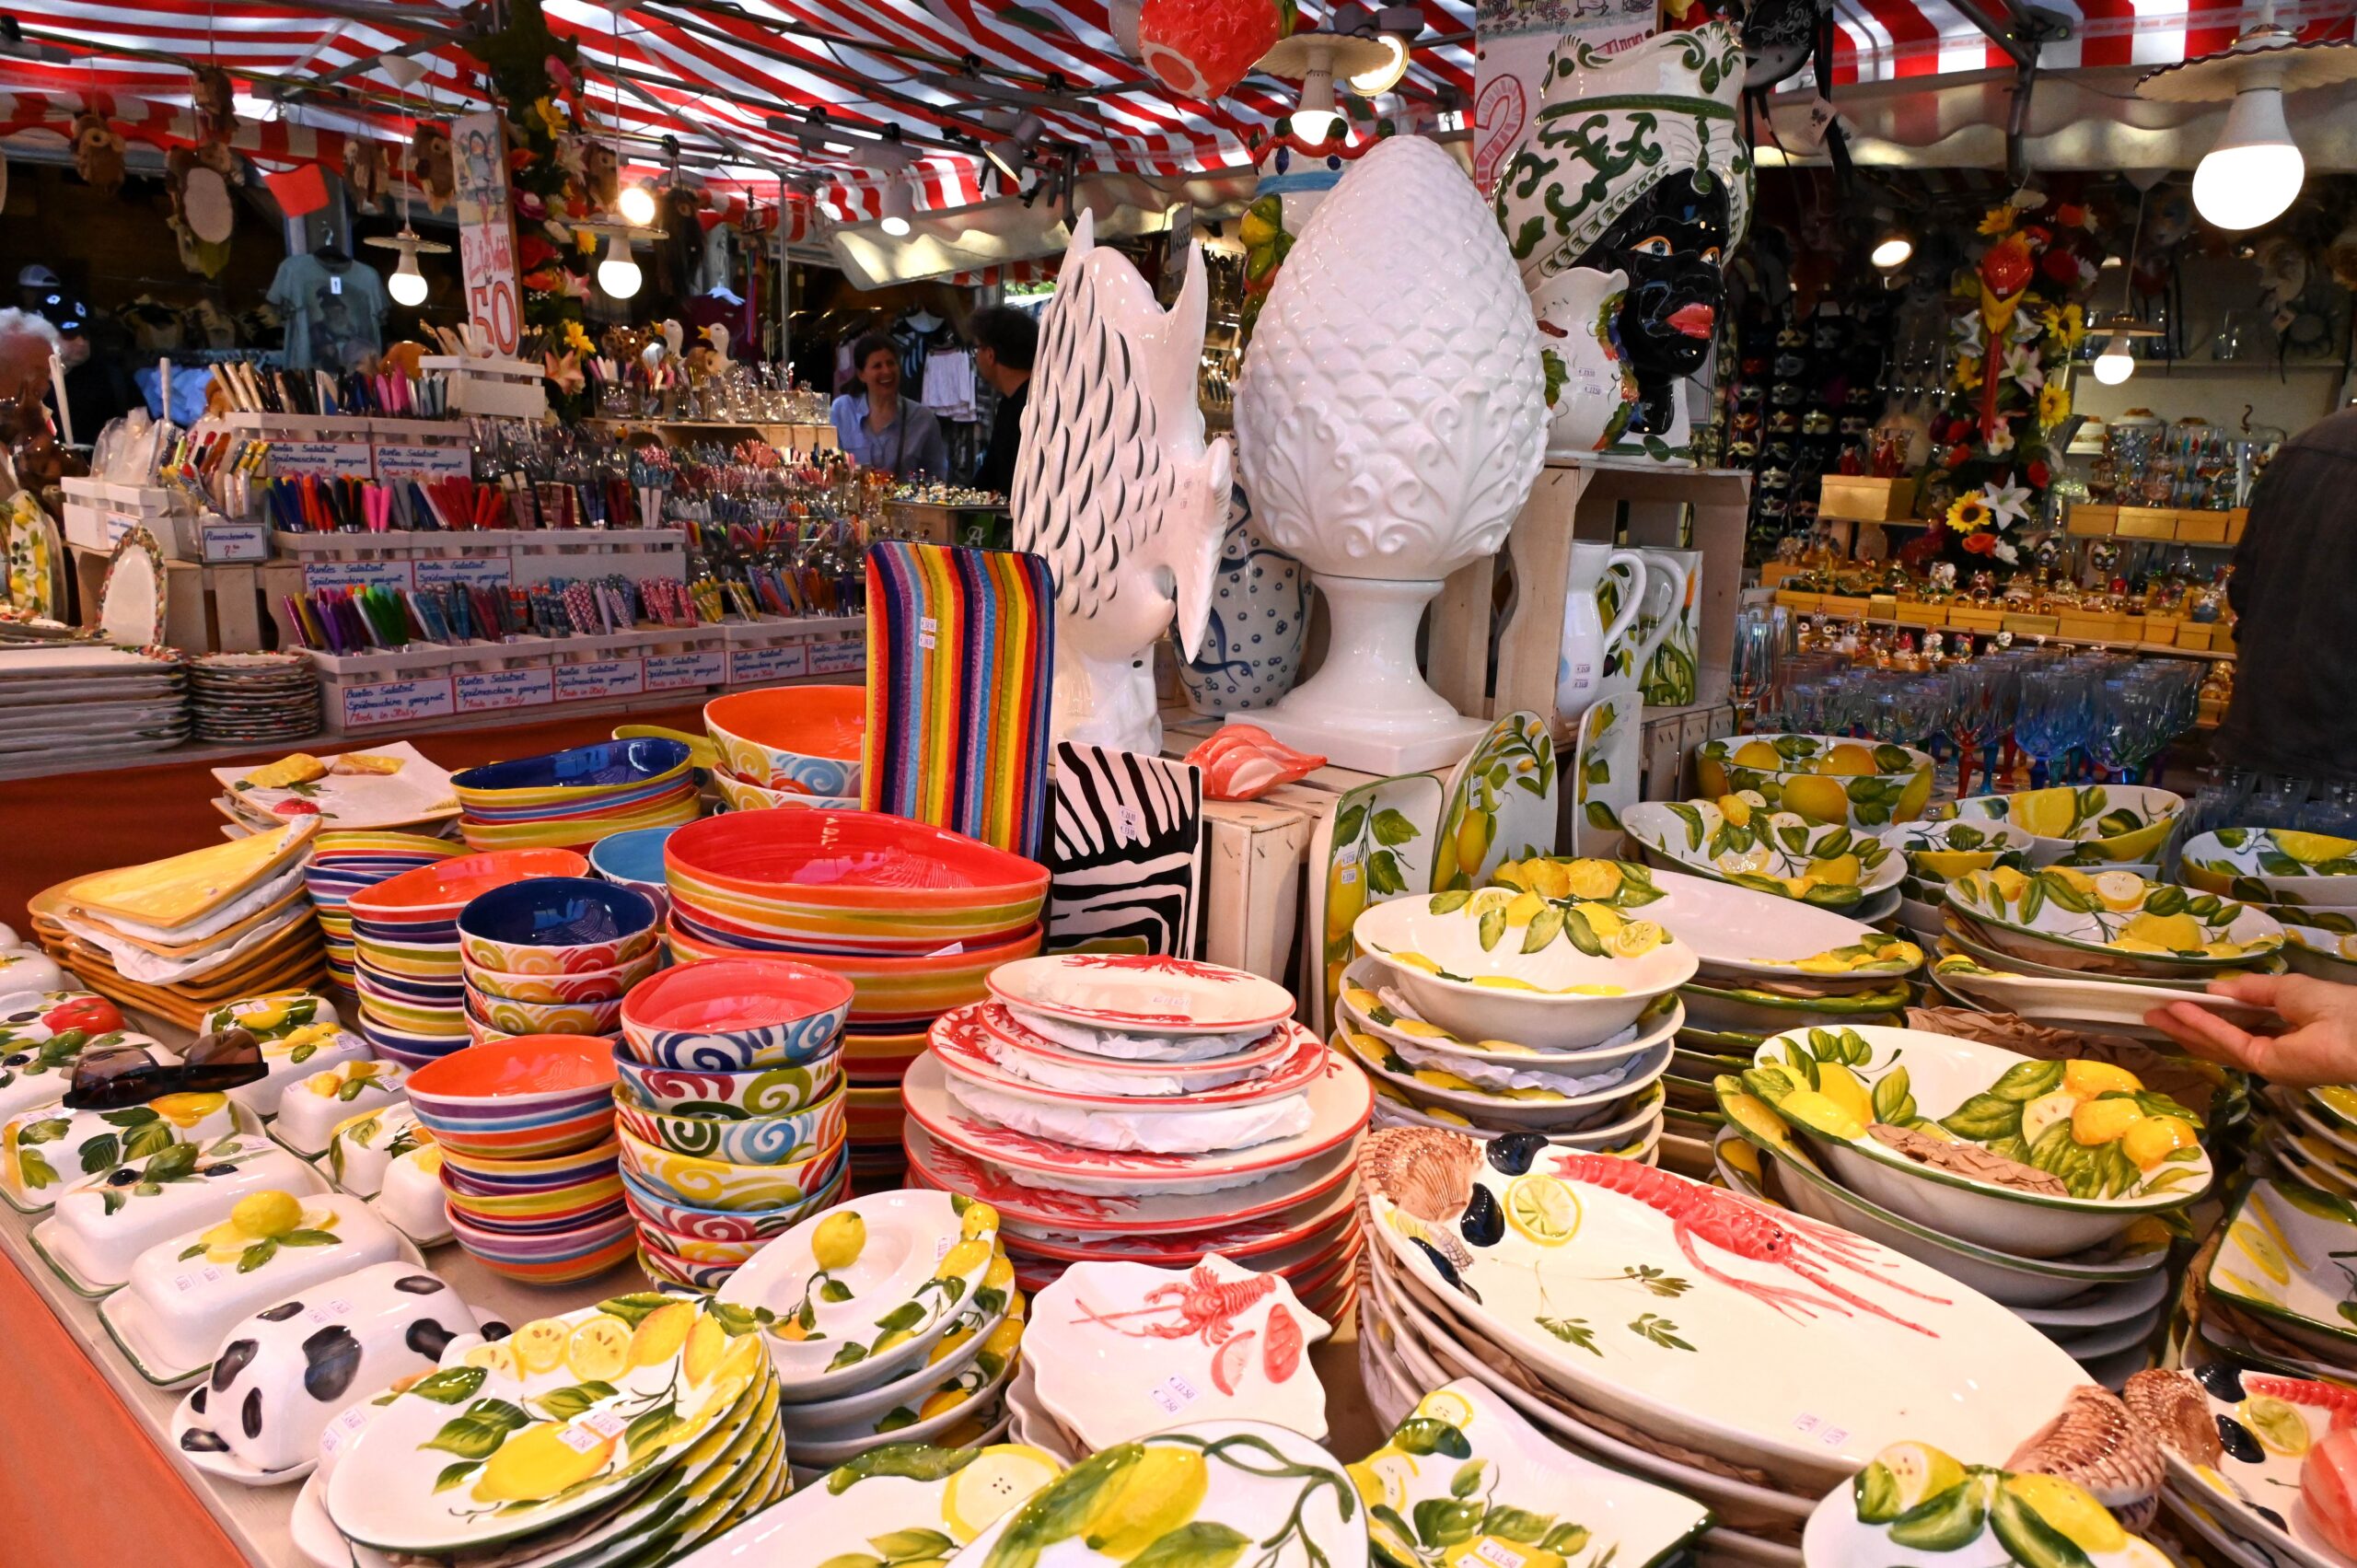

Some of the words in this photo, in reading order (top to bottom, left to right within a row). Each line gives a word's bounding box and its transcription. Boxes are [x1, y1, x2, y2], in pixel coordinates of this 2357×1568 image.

[458, 676, 484, 686] Buntes
[346, 689, 374, 699] Buntes
[349, 711, 373, 723] Made
[390, 706, 418, 717] Italy
